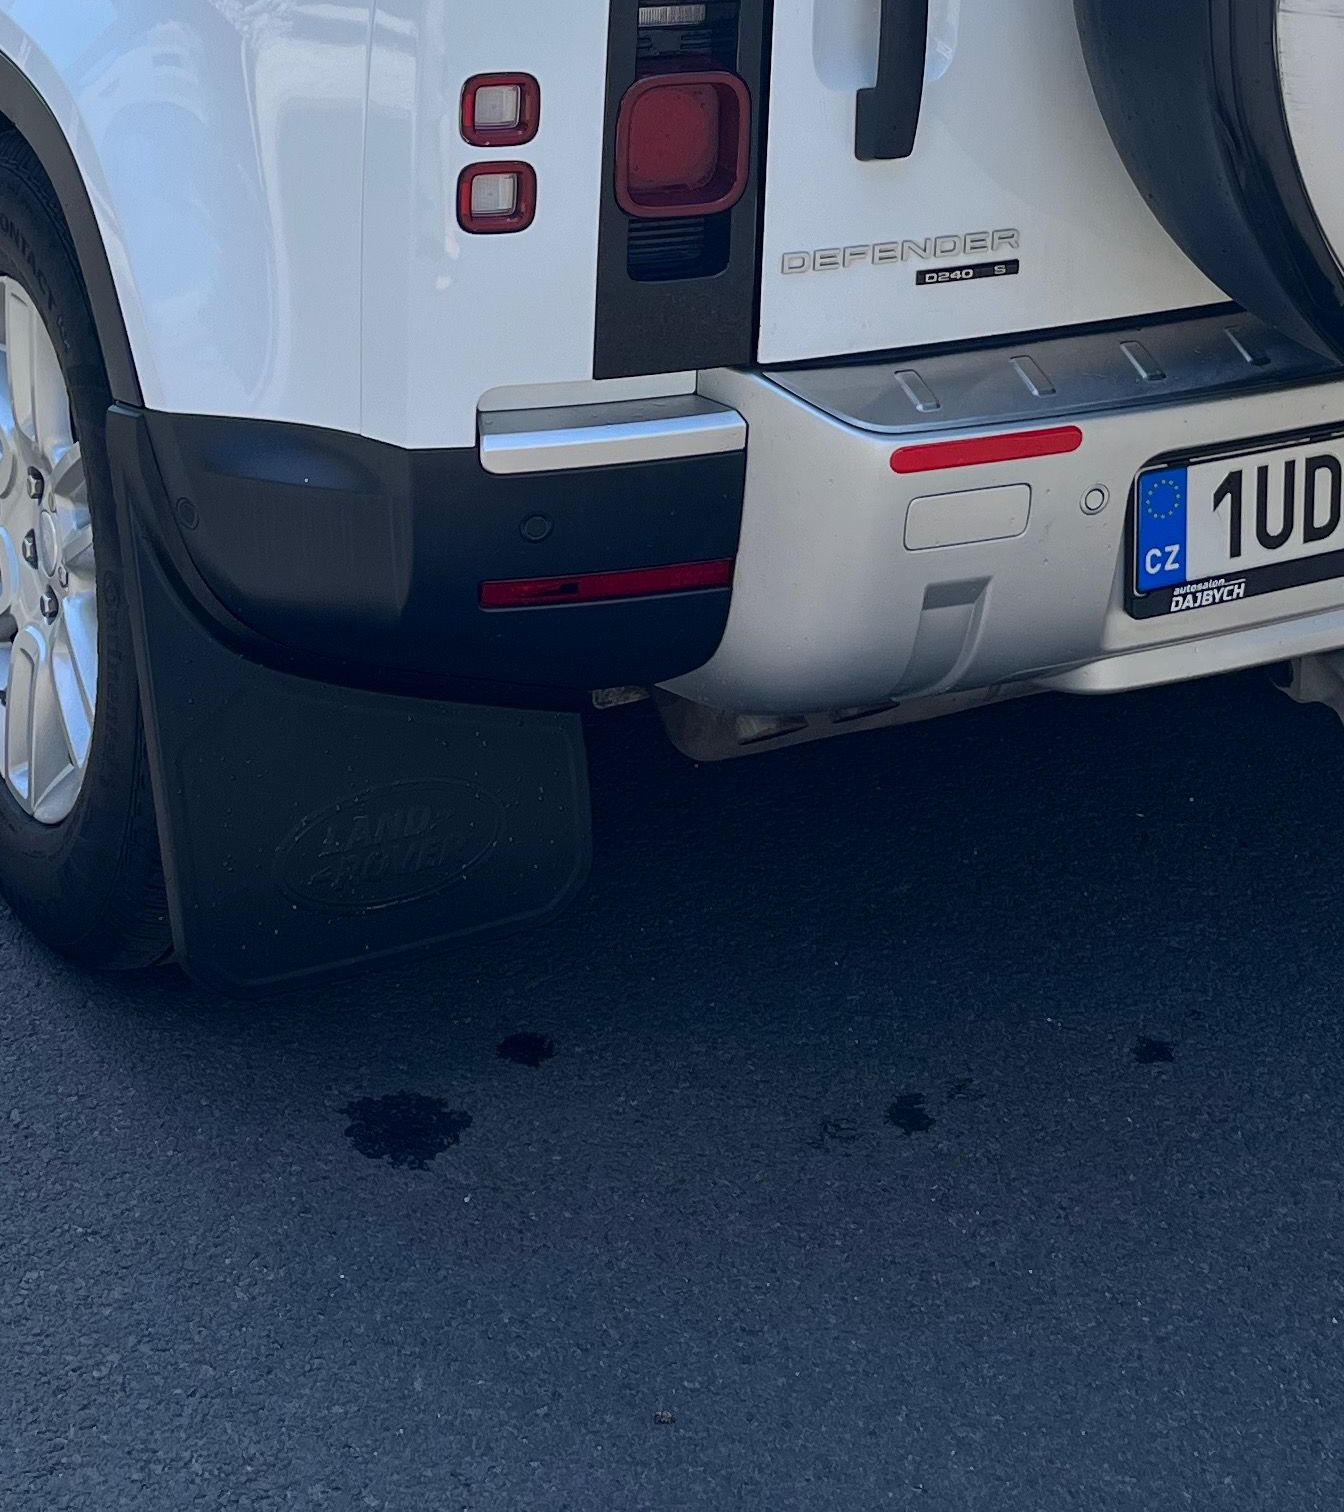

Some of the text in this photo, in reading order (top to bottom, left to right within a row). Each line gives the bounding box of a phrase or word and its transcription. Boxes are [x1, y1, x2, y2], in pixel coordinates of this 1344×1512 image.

[781, 228, 1020, 275] DEFENDER
[925, 265, 1007, 284] D240 S
[1212, 454, 1342, 559] 1UD
[1145, 544, 1180, 575] CZ
[1170, 582, 1246, 612] DAJBYCH
[1173, 578, 1225, 596] autosalon
